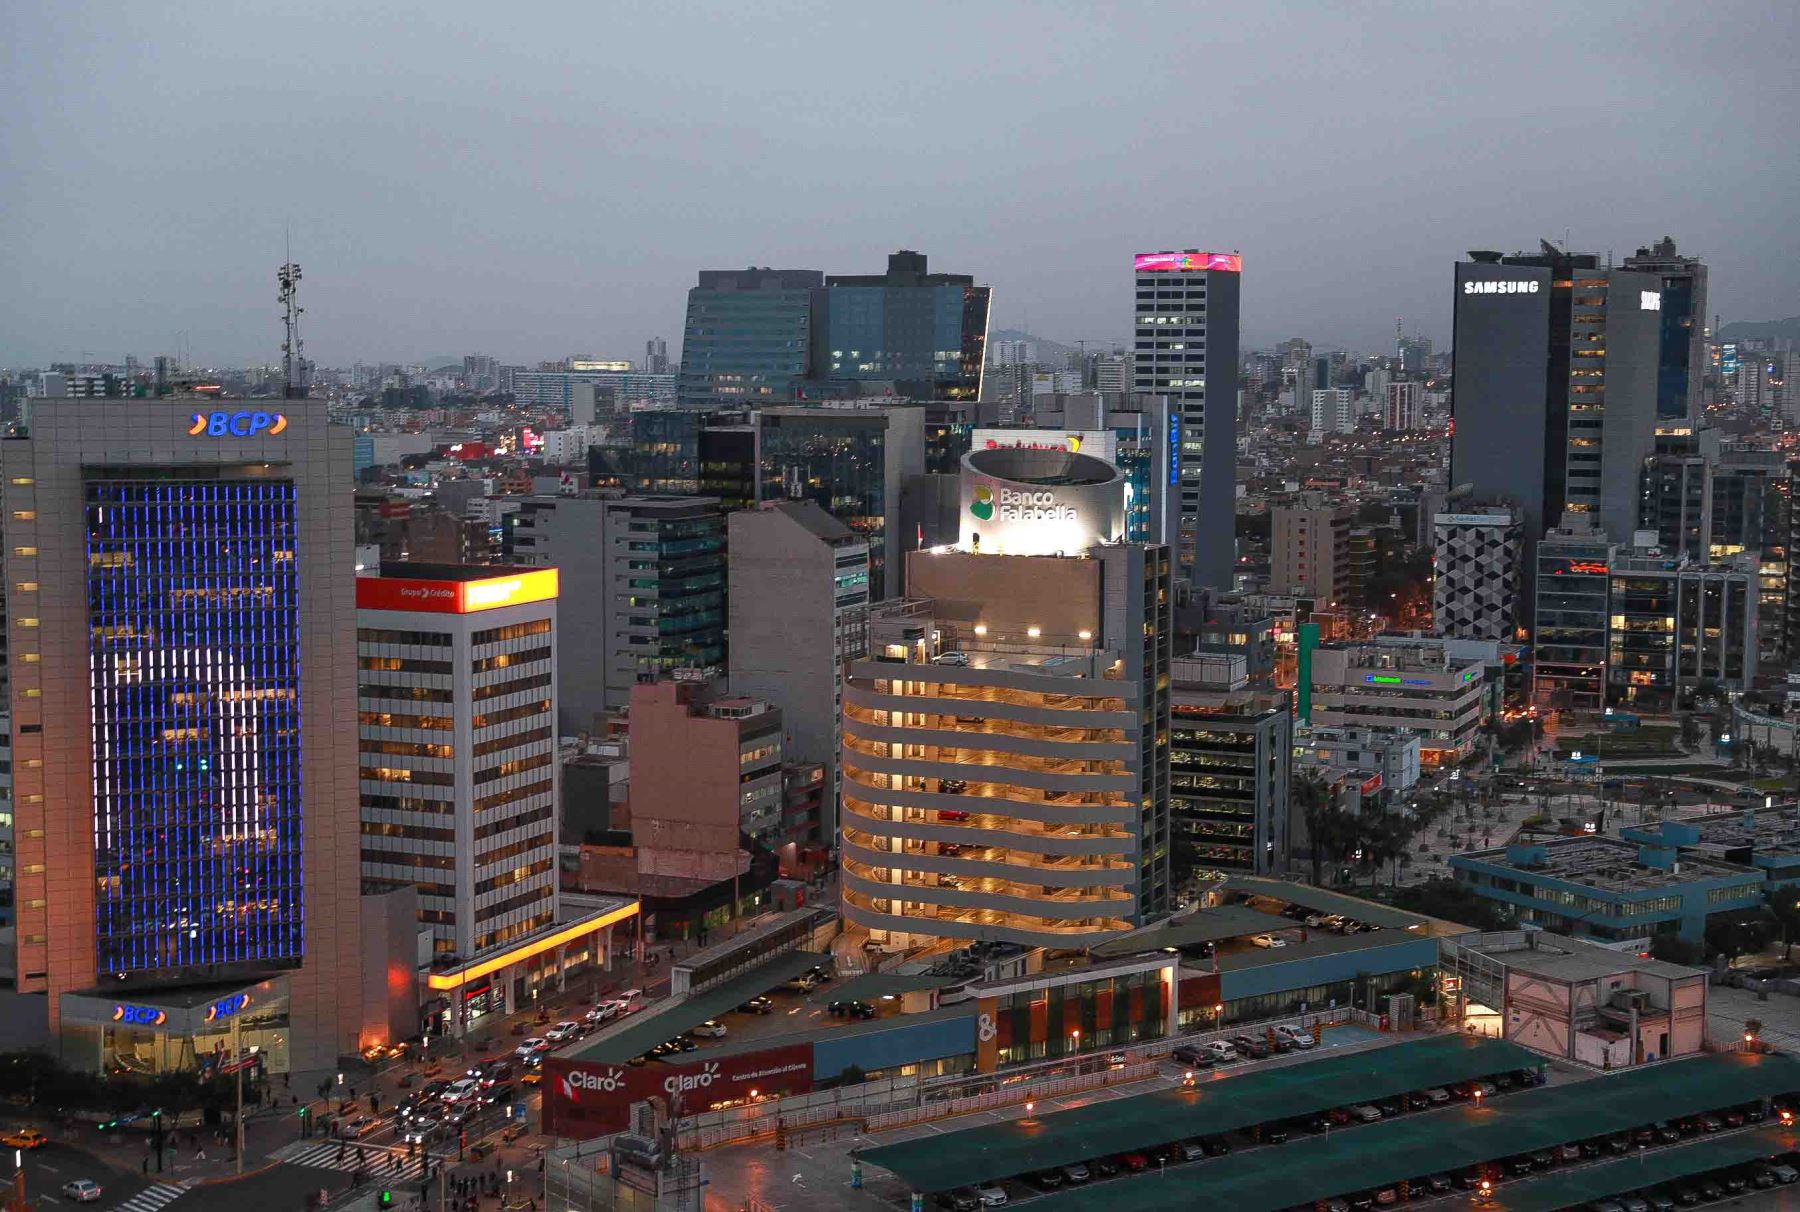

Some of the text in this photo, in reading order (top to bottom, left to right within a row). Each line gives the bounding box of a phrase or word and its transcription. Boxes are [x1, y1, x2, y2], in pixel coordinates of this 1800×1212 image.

[1464, 281, 1539, 294] SAMSUNG
[208, 411, 270, 437] BCP
[1000, 488, 1054, 505] Banco
[1000, 504, 1077, 521] Falabella
[123, 1005, 157, 1023] BCP
[216, 993, 244, 1019] BCP
[568, 1071, 616, 1091] Claro
[664, 1072, 712, 1093] Claro
